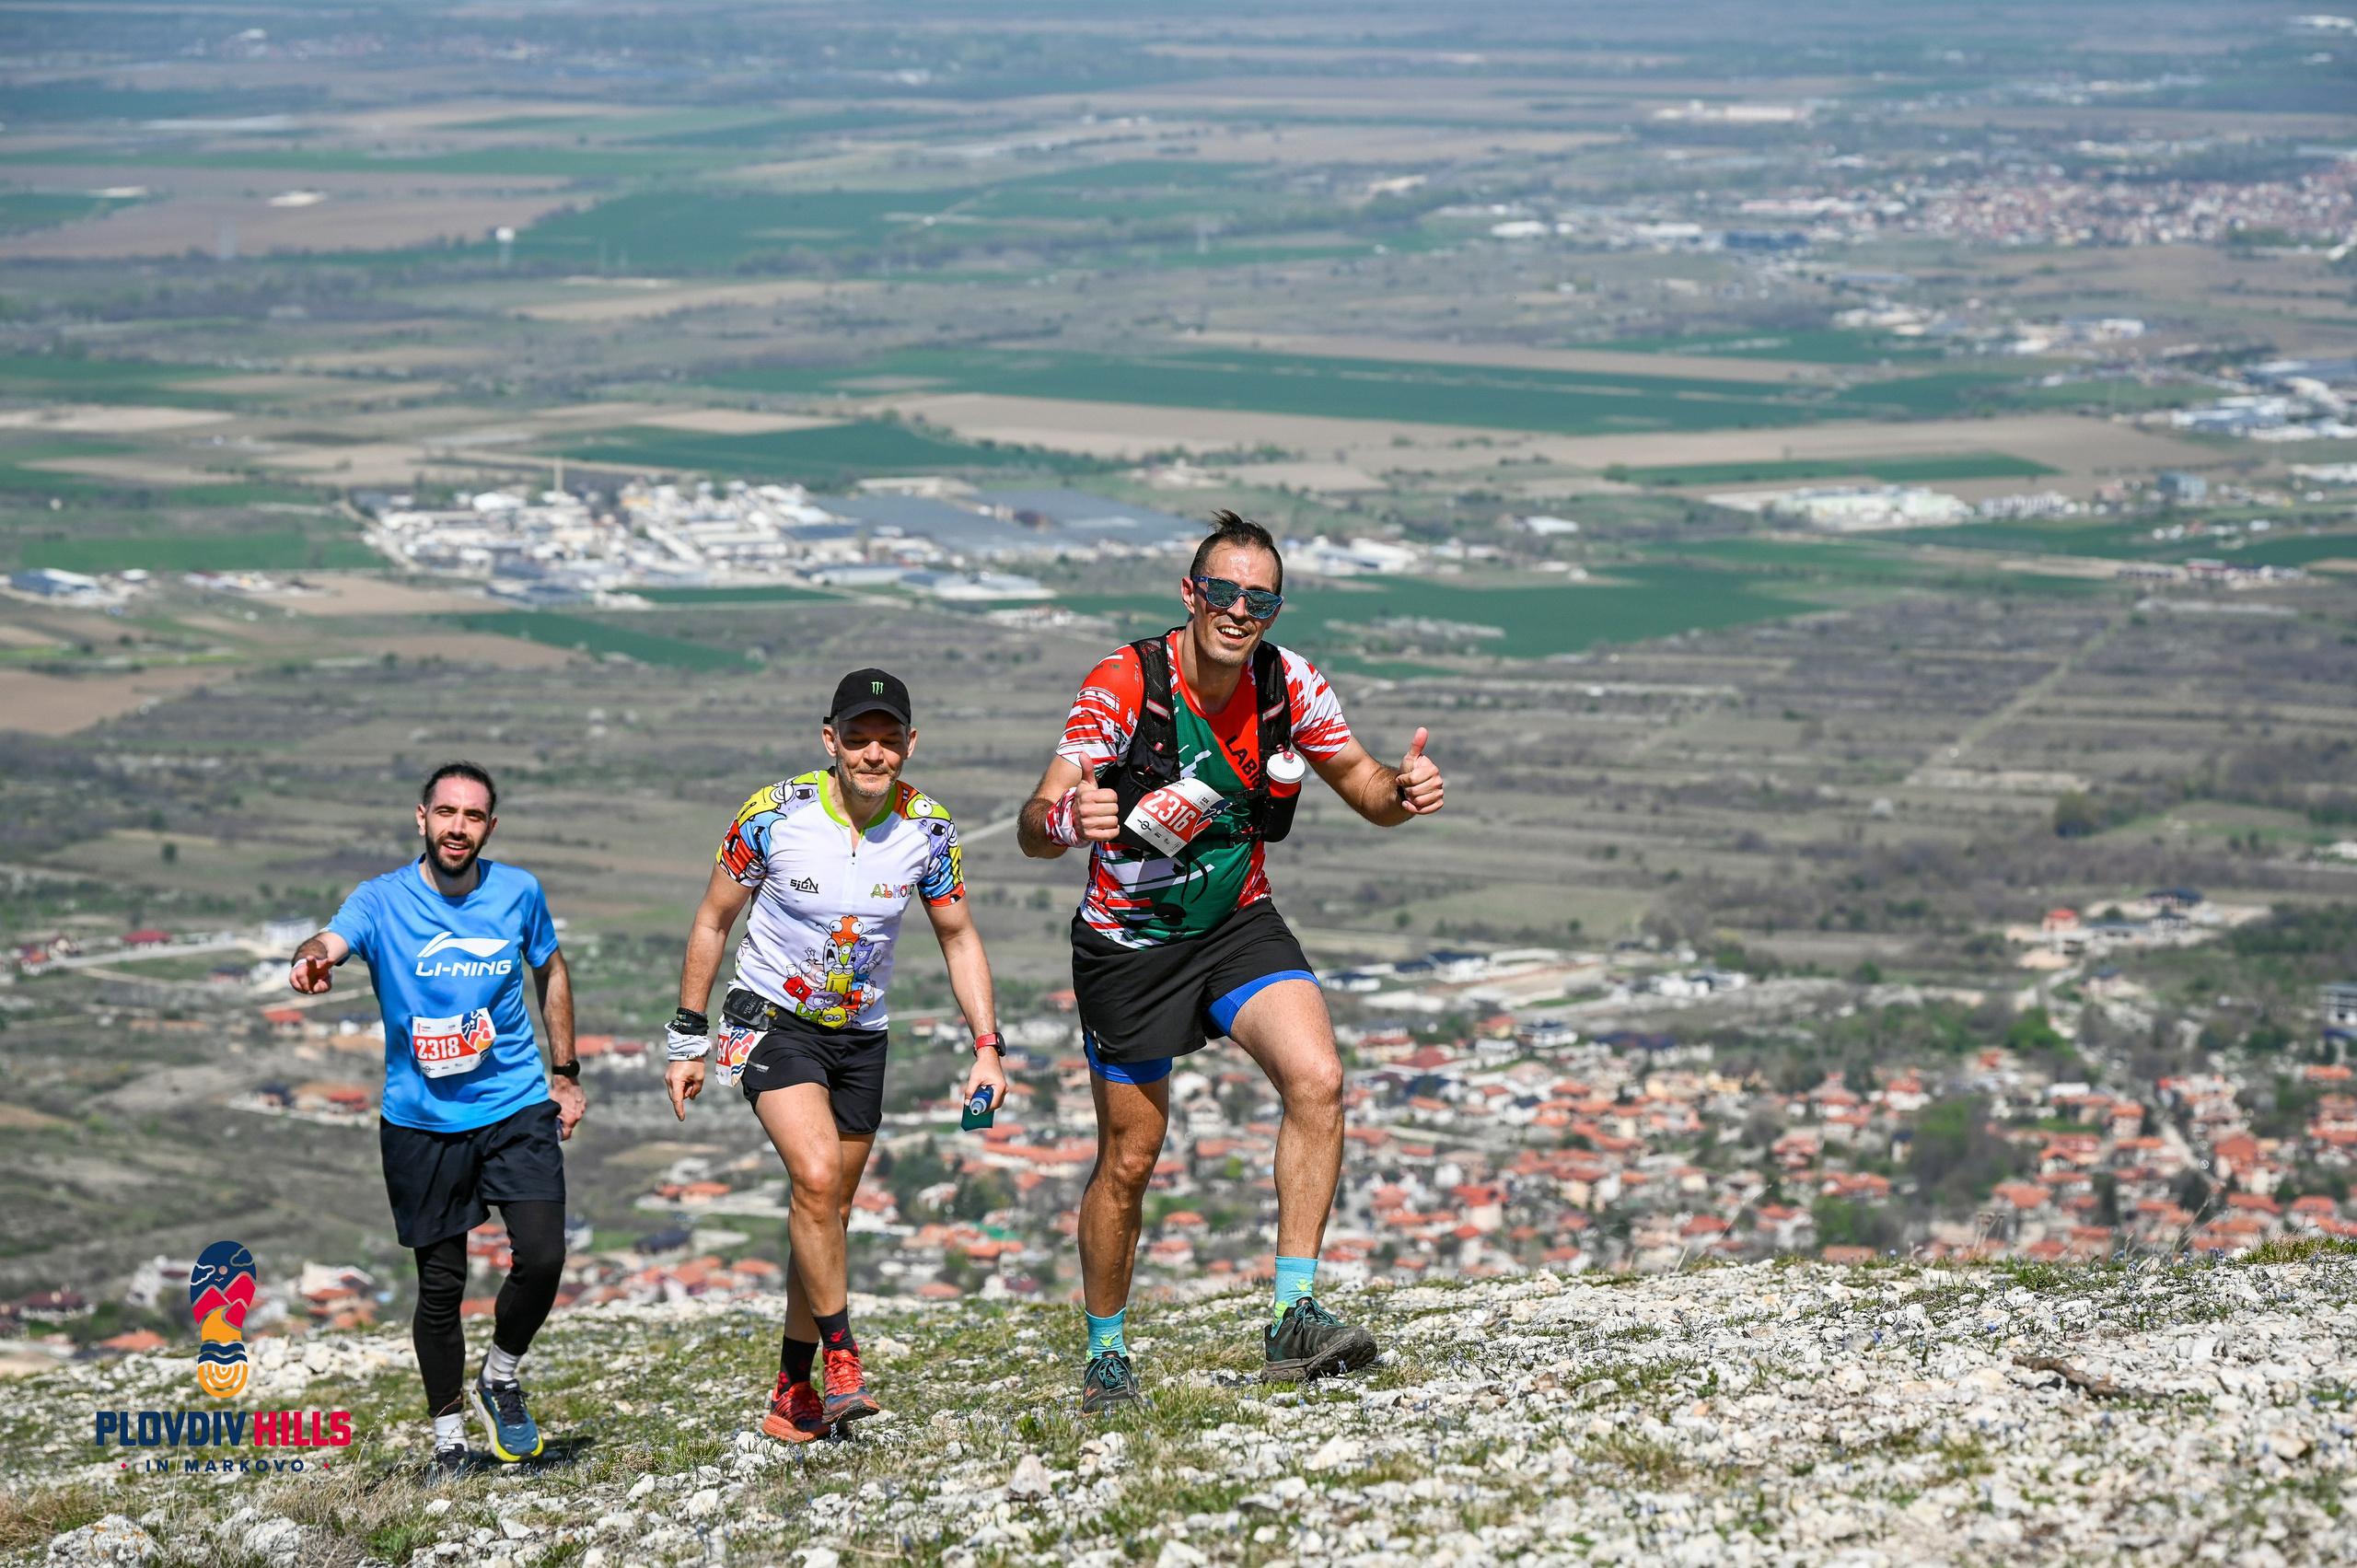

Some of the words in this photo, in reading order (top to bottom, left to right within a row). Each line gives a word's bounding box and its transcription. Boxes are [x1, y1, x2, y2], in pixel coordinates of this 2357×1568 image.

[1143, 789, 1197, 832] 2316
[415, 959, 512, 977] LI-NING
[416, 1037, 460, 1060] 2318
